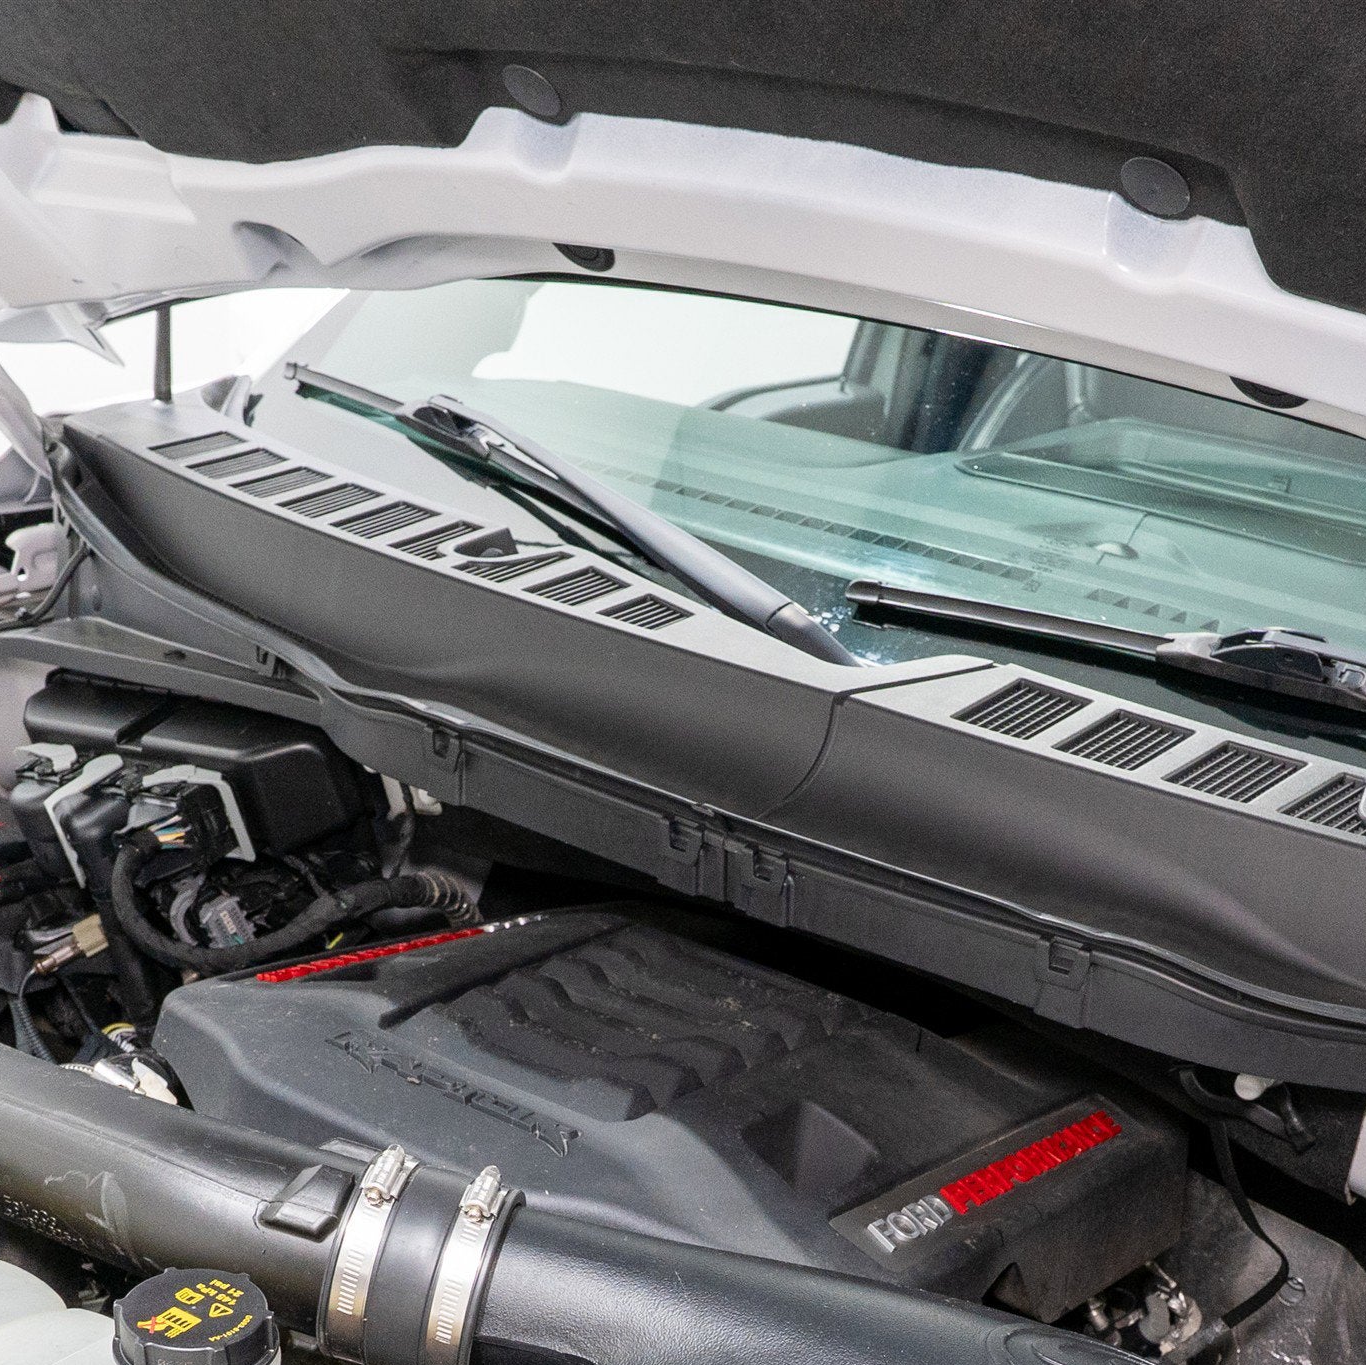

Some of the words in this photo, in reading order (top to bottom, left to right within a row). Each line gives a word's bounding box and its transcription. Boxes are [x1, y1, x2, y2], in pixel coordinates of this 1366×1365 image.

[867, 1194, 953, 1253] FORD
[939, 1110, 1123, 1215] PERFORMANCE
[209, 1279, 231, 1290] psi
